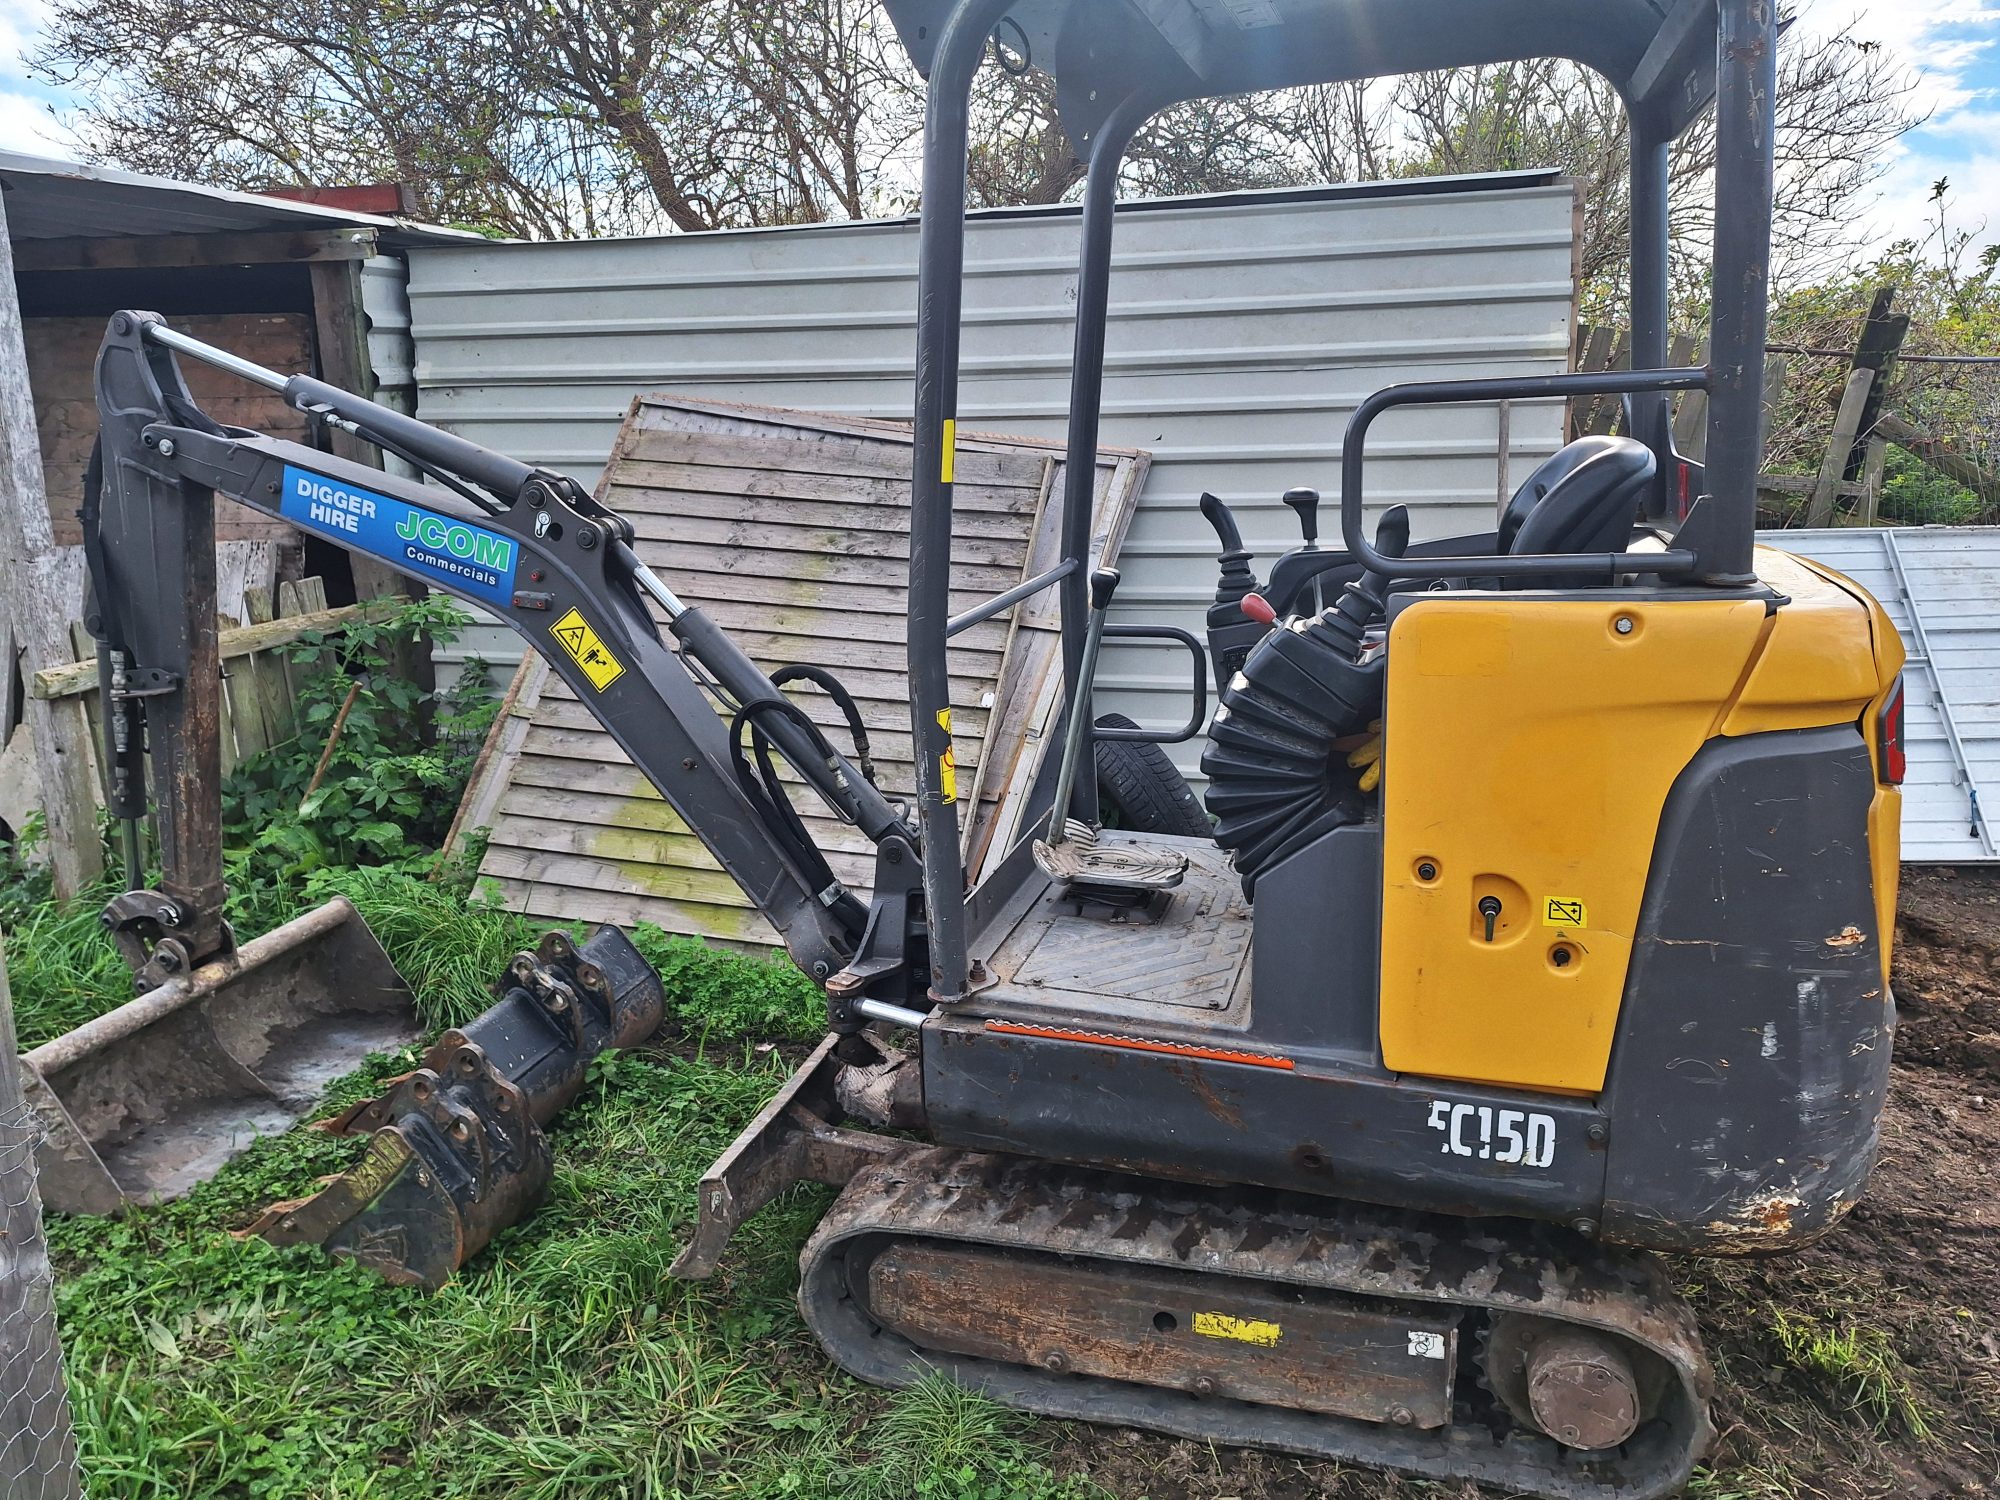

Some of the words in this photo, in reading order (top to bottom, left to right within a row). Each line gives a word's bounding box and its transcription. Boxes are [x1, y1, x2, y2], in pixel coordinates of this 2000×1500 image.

[297, 479, 376, 519] DIGGER
[310, 503, 359, 533] HIRE
[395, 511, 511, 572] JCOM
[407, 547, 496, 585] Commercials
